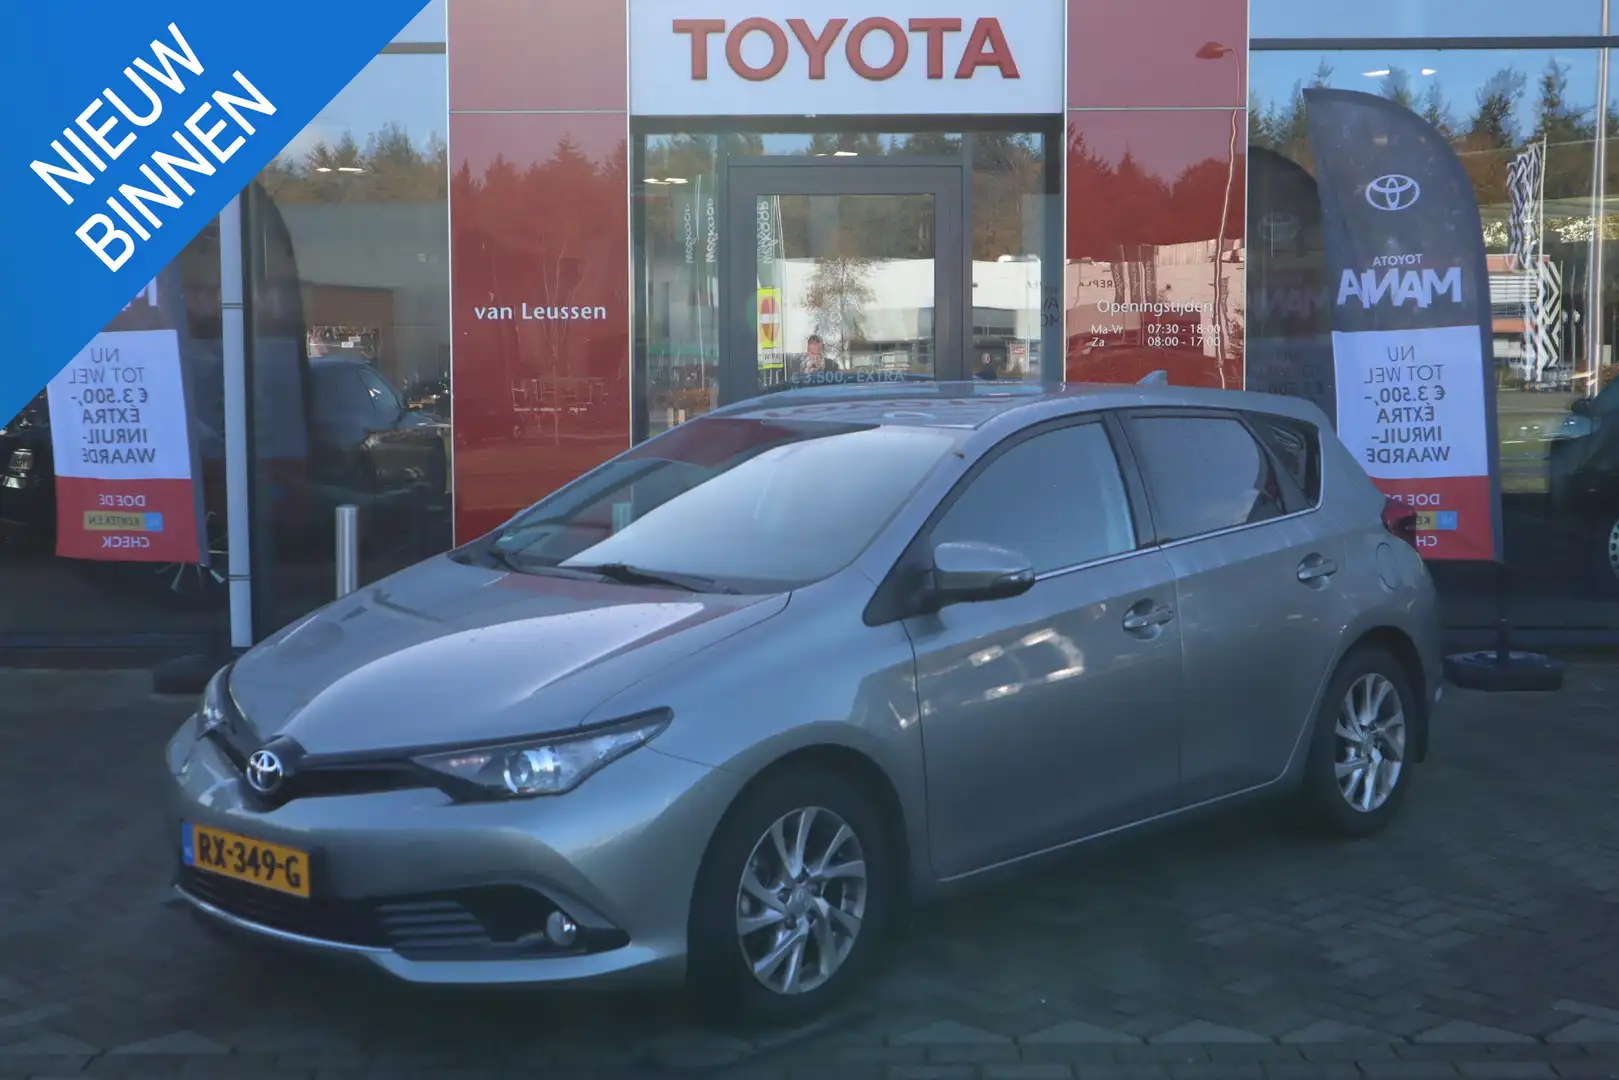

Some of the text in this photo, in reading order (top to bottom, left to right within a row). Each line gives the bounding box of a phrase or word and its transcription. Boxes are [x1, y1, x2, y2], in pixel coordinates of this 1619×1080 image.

[672, 17, 1021, 82] TOYOTA
[474, 302, 607, 320] van Leussen
[1097, 299, 1213, 317] Openingstijden
[1091, 324, 1123, 335] Ma-Vr
[1147, 324, 1179, 334] 07:30
[1091, 337, 1105, 347] Za
[1147, 336, 1179, 347] 08:00
[198, 831, 301, 889] RX-349-G
